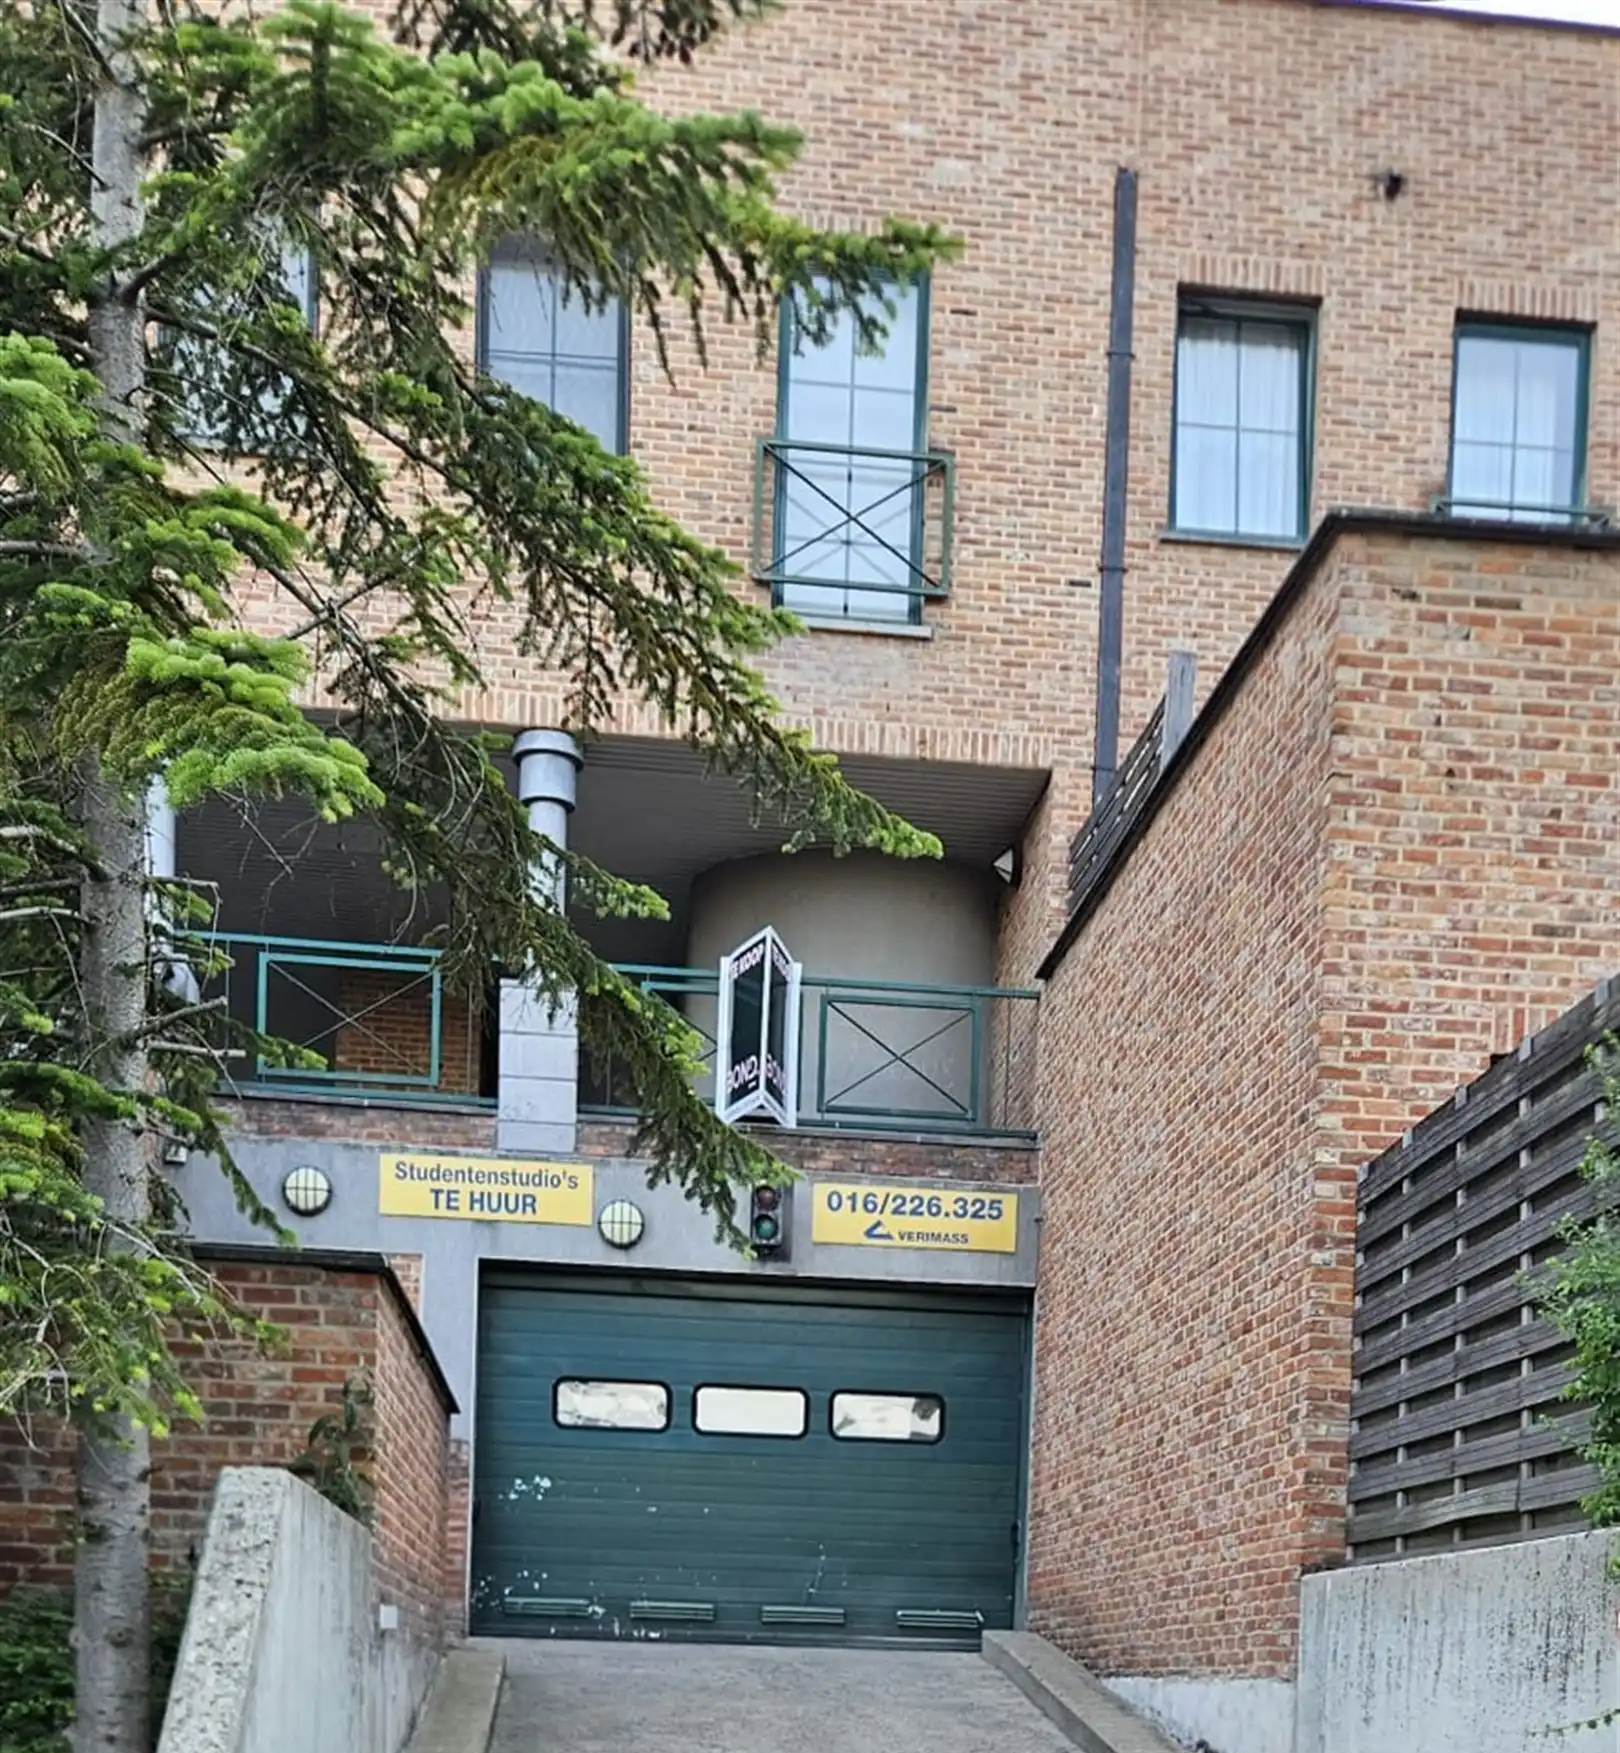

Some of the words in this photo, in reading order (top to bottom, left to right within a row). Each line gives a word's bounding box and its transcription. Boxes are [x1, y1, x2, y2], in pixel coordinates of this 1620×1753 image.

[394, 1160, 580, 1190] Studentenstudio's
[430, 1188, 460, 1212] TE
[469, 1190, 537, 1215] HUUR
[826, 1190, 1004, 1221] 016/226.325
[898, 1230, 969, 1245] VERIMASS
